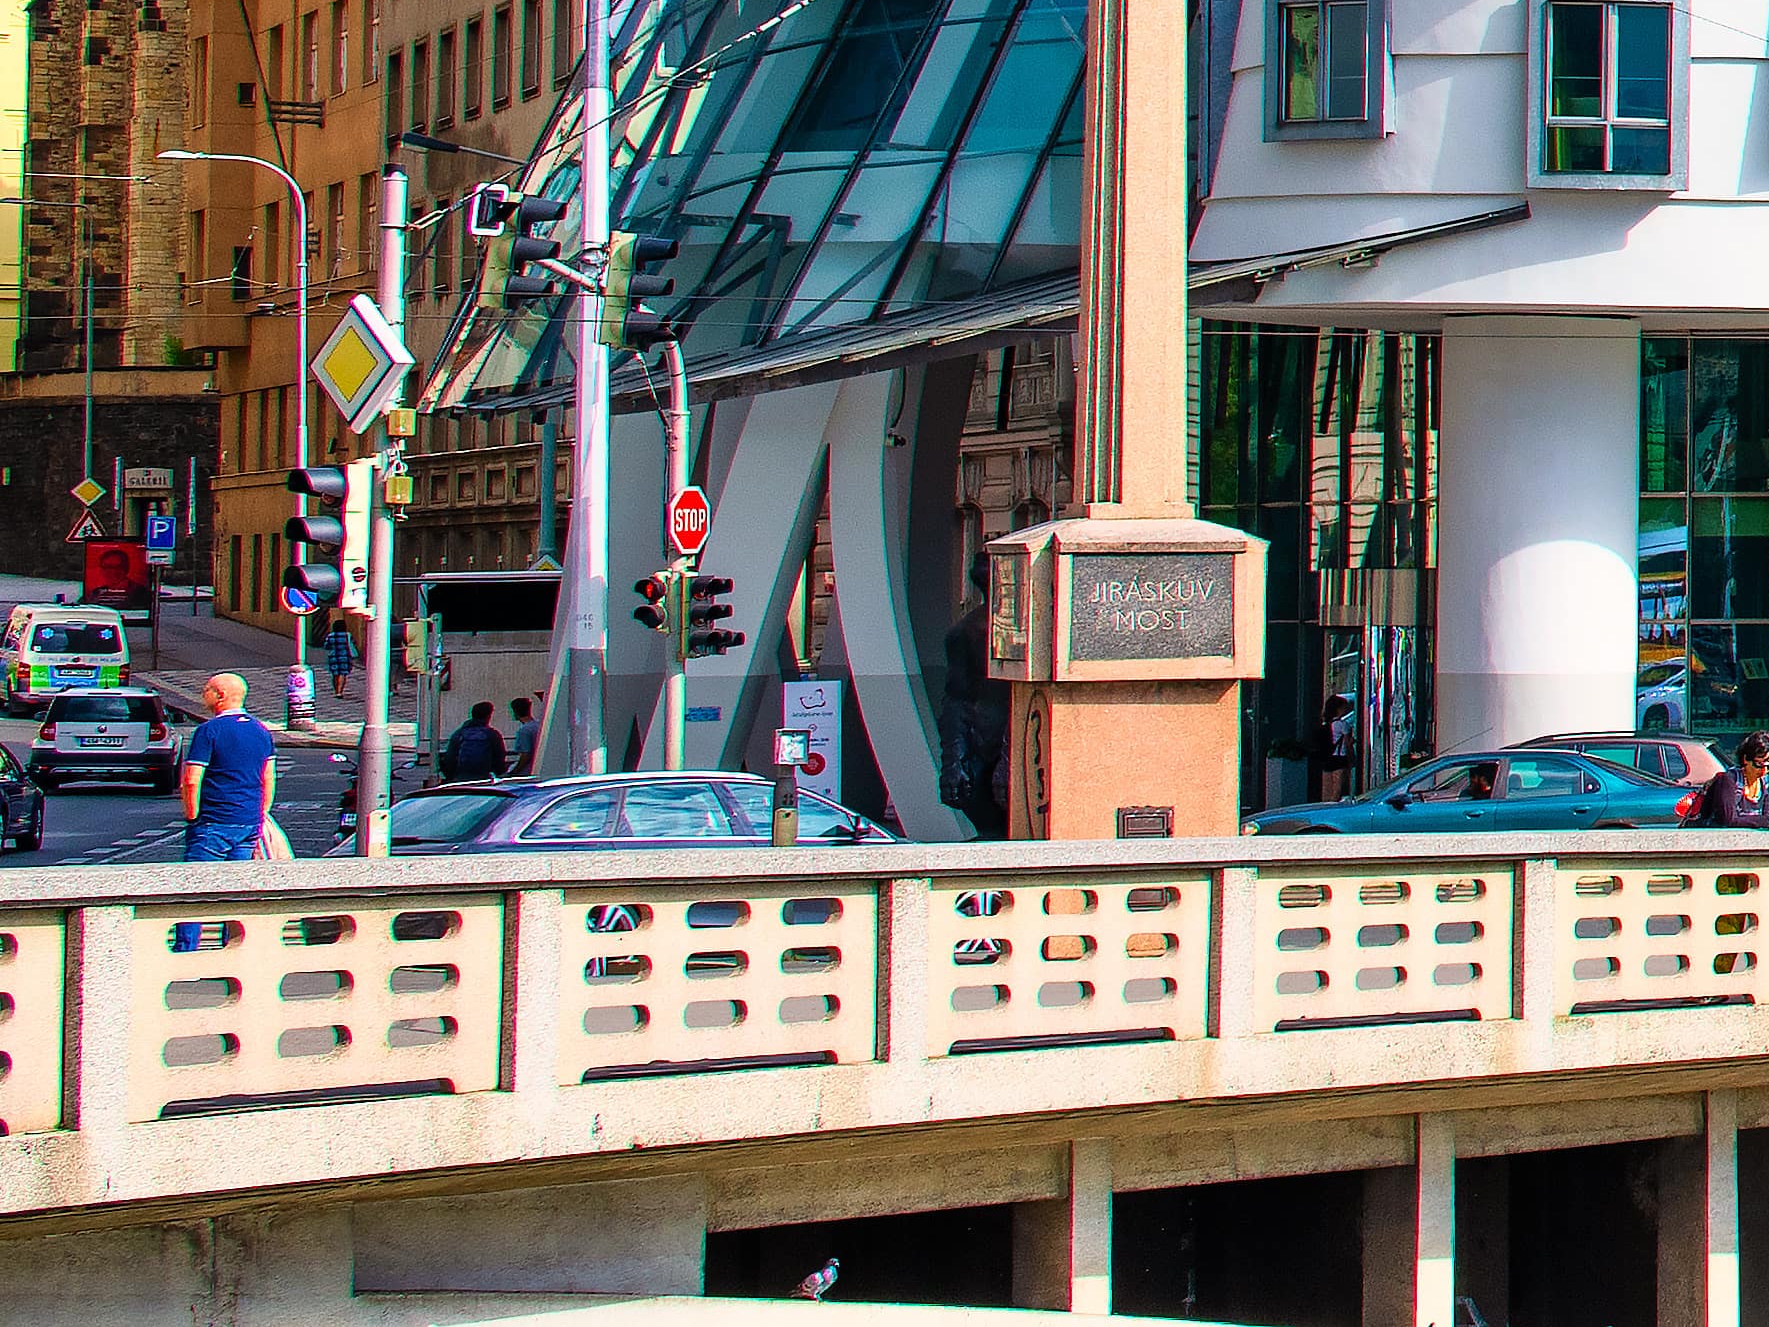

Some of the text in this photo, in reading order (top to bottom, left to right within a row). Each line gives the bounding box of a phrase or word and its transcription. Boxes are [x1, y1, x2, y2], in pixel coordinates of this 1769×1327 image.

[153, 520, 170, 539] P
[675, 508, 707, 532] STOP
[1114, 607, 1190, 631] MOST
